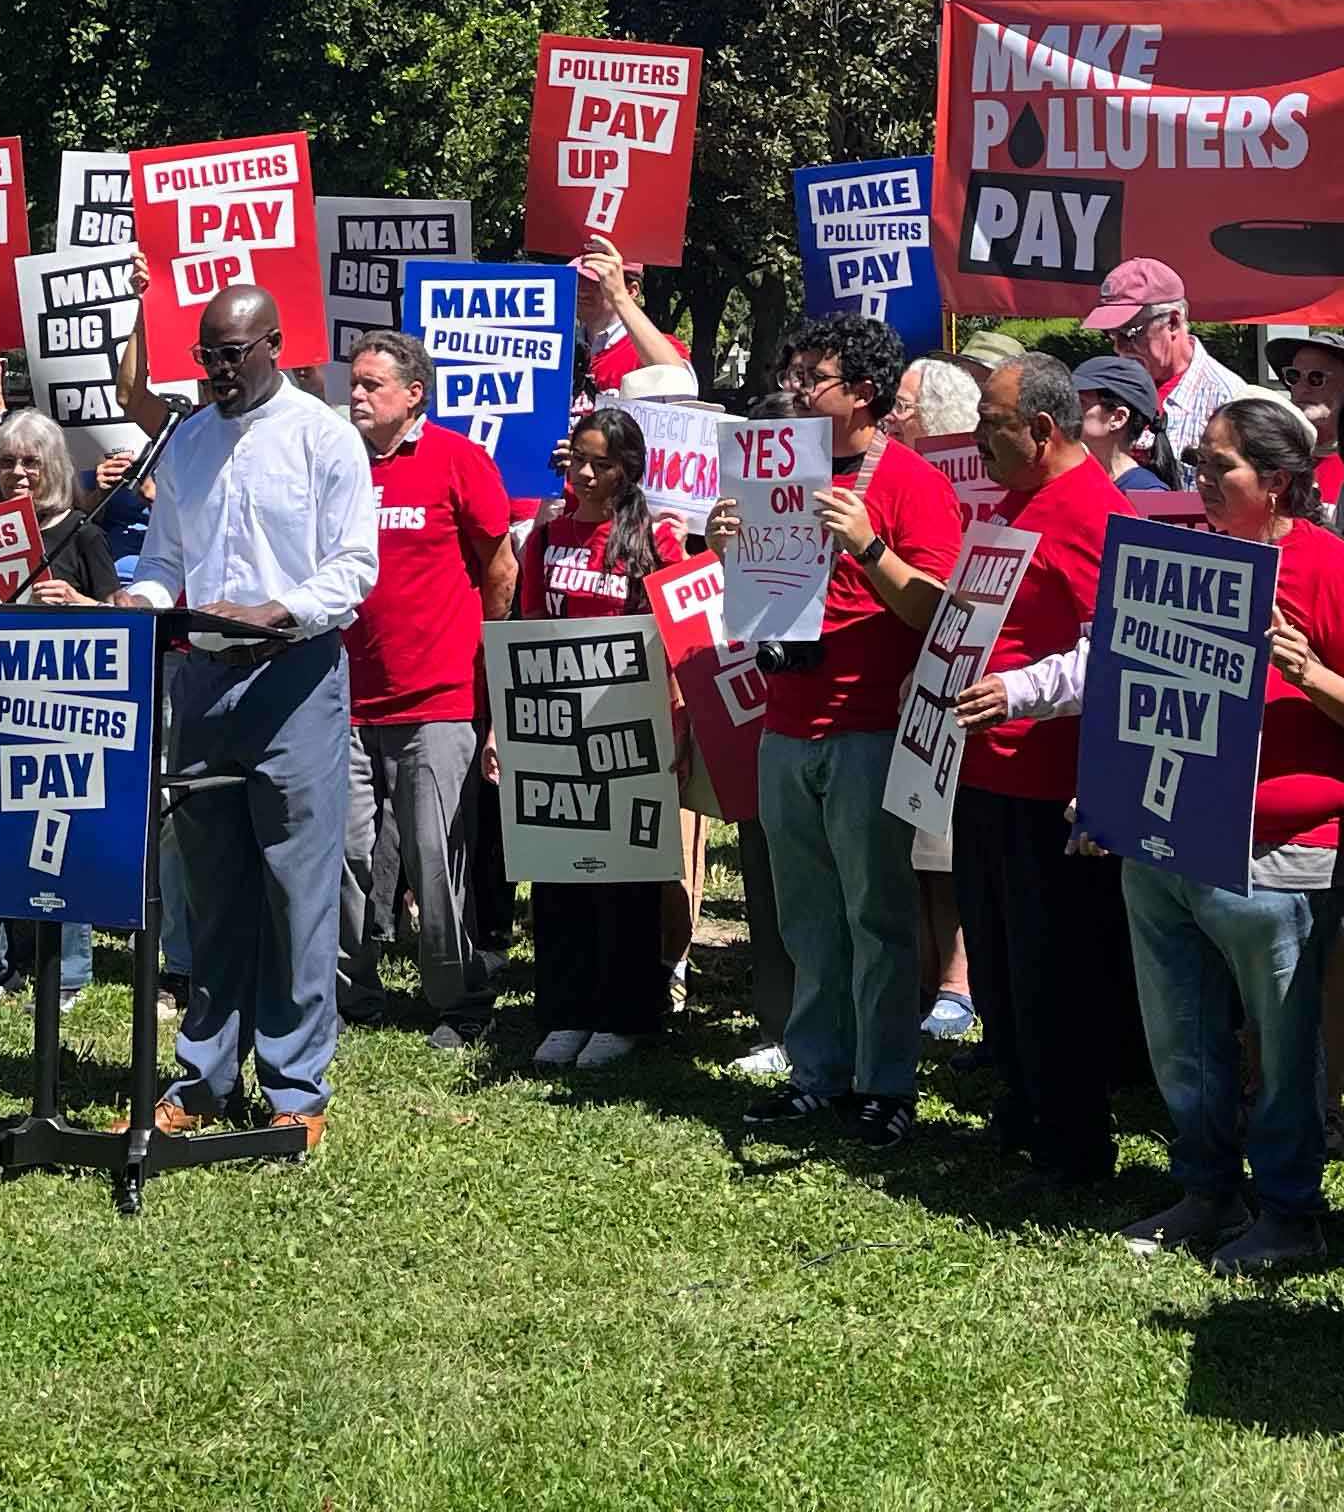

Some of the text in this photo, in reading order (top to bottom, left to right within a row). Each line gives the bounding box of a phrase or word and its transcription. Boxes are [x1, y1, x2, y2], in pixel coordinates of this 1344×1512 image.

[558, 58, 680, 86] POLLUTERS
[971, 24, 1163, 92] MAKE
[579, 95, 668, 143] PAY
[155, 154, 288, 193] POLLUTERS
[568, 149, 619, 179] UP
[596, 192, 615, 224] !
[816, 177, 912, 216] MAKE
[79, 210, 133, 244] BIG
[190, 201, 283, 244] PAY
[345, 220, 448, 251] MAKE
[823, 222, 922, 243] POLLUTERS
[969, 186, 1111, 272] PAY
[49, 263, 135, 308] MAK
[184, 256, 242, 296] UP
[338, 260, 391, 294] BIG
[837, 251, 900, 290] PAY
[431, 288, 545, 319] MAKE
[46, 314, 103, 352] BIG
[433, 330, 553, 361] POLLUTERS
[445, 371, 524, 408] PAY
[735, 427, 796, 479] YES
[928, 454, 987, 484] OLLUT
[770, 485, 805, 514] ON
[544, 566, 629, 599] LLUTERS
[961, 554, 1020, 597] MAKE
[1123, 555, 1242, 619] MAKE
[545, 592, 564, 616] AY
[935, 604, 968, 653] BIG
[517, 639, 639, 685] MAKE
[1120, 616, 1246, 684] POLLUTERS
[514, 697, 573, 738] BIG
[907, 699, 943, 754] PAY
[1128, 683, 1211, 741] PAY
[587, 729, 649, 773] OIL
[9, 752, 94, 800] PAY
[1153, 756, 1174, 807] !
[522, 779, 602, 822] PAY
[41, 819, 60, 864] !
[638, 805, 655, 841] !
